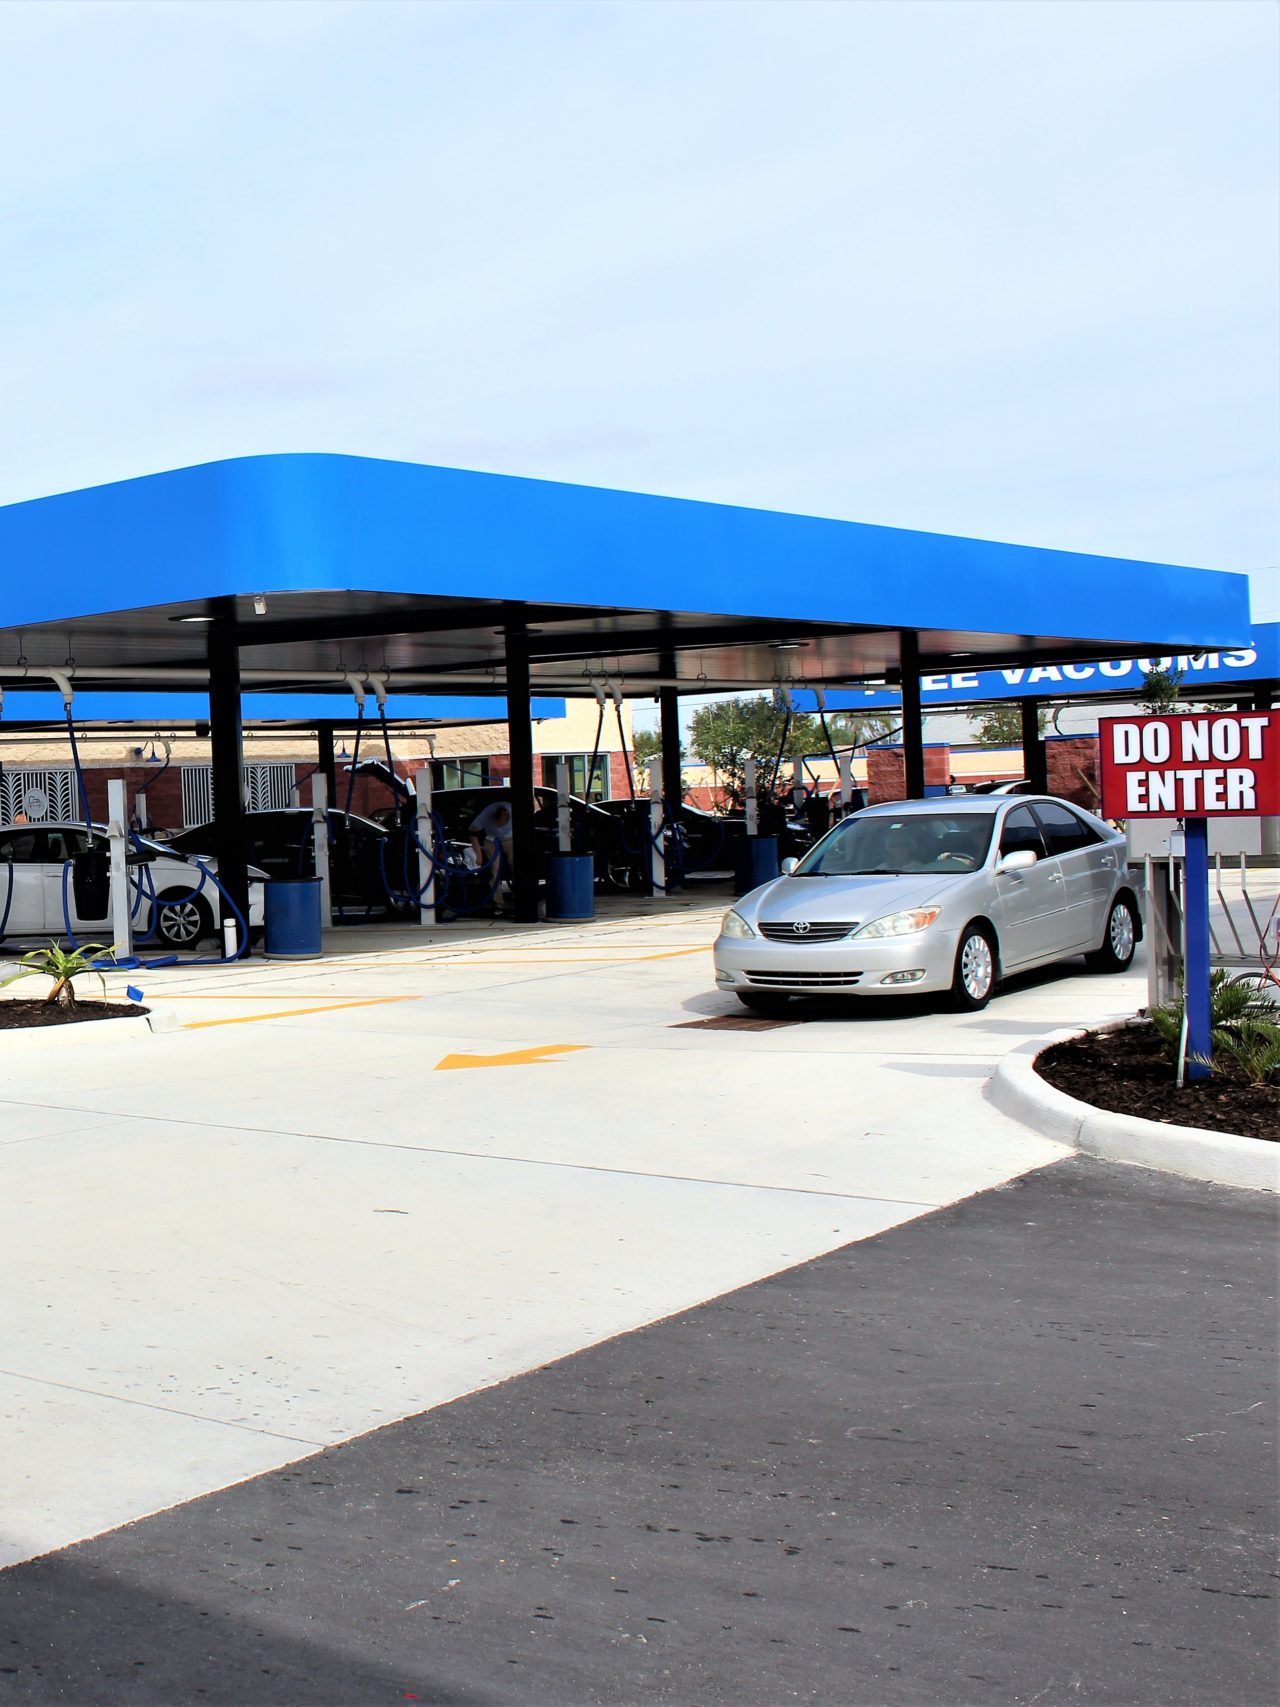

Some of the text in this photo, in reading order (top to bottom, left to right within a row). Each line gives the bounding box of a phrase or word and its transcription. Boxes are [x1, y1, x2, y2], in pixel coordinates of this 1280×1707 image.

[1113, 717, 1269, 764] DO NOT
[1126, 768, 1256, 812] ENTER
